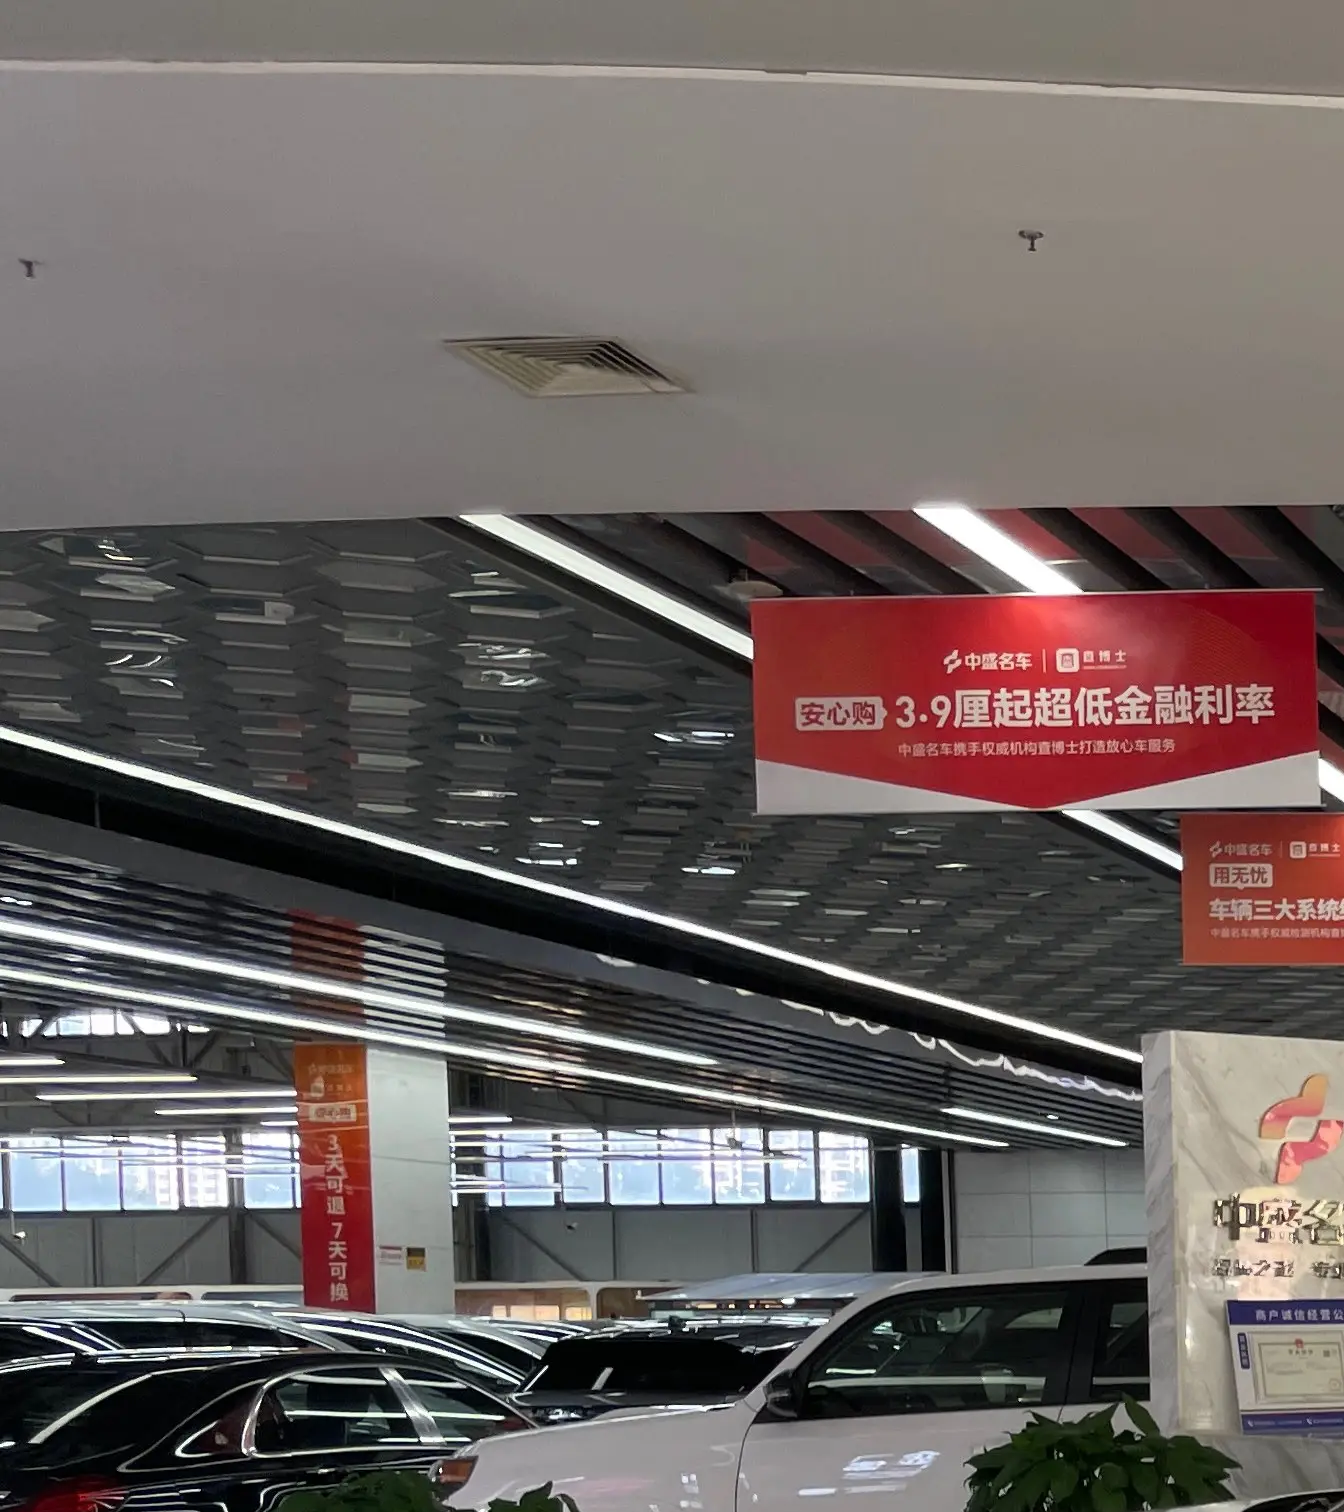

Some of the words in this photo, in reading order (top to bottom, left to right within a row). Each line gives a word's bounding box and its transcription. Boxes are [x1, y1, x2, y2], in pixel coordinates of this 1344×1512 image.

[965, 652, 1032, 672] 中盛名车
[801, 702, 877, 727] 安心购
[895, 683, 1275, 729] 3.9厘起超低金融利率
[1213, 866, 1269, 885] 用无忧
